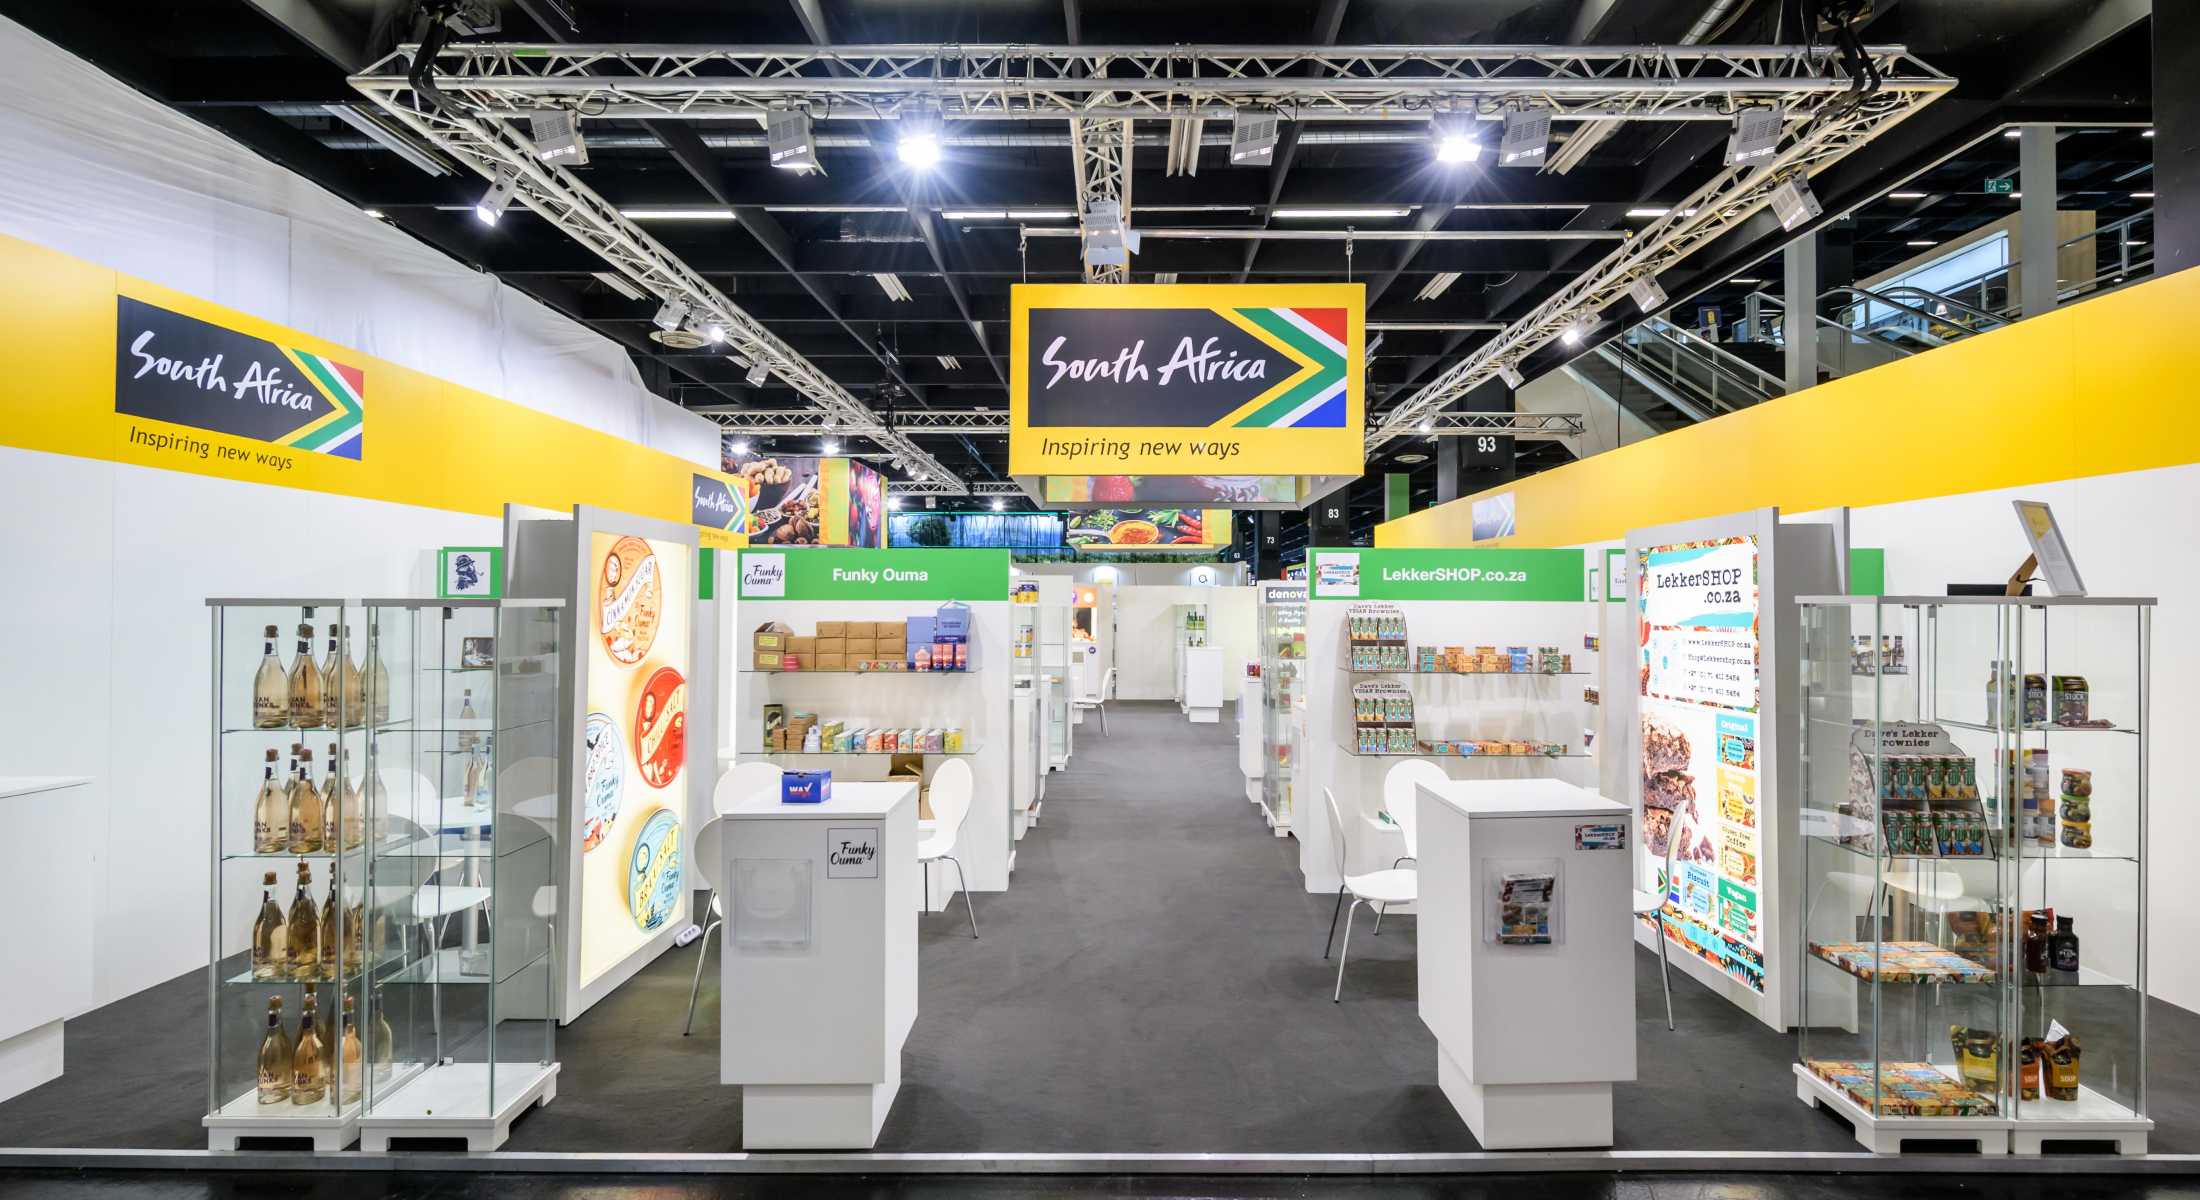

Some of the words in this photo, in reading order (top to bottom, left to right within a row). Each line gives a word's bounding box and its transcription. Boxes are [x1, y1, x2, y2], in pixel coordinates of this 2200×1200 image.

[130, 330, 227, 393] South
[233, 360, 313, 412] Africa
[1042, 336, 1149, 390] South
[1156, 336, 1266, 386] Africa
[129, 425, 209, 459] Inspiring
[217, 444, 251, 462] new
[255, 451, 293, 470] ways
[1041, 437, 1130, 460] Inspiring
[1139, 441, 1182, 456] new
[1189, 440, 1240, 461] ways
[1477, 436, 1496, 453] 93
[1328, 508, 1339, 519] 83
[1266, 536, 1275, 544] 73
[744, 573, 773, 586] Ouma
[752, 564, 784, 582] Funky
[832, 567, 879, 585] Funky
[882, 567, 928, 582] Ouma
[1382, 567, 1527, 583] LekkerSHOP.co.za
[1656, 567, 1742, 589] LekkerSHOP
[1703, 590, 1742, 604] .co.za
[2064, 693, 2085, 701] STOCK
[1902, 729, 1939, 738] Lekker
[830, 852, 863, 865] Ouma
[840, 841, 876, 861] Funky
[2059, 1074, 2077, 1083] SOUP
